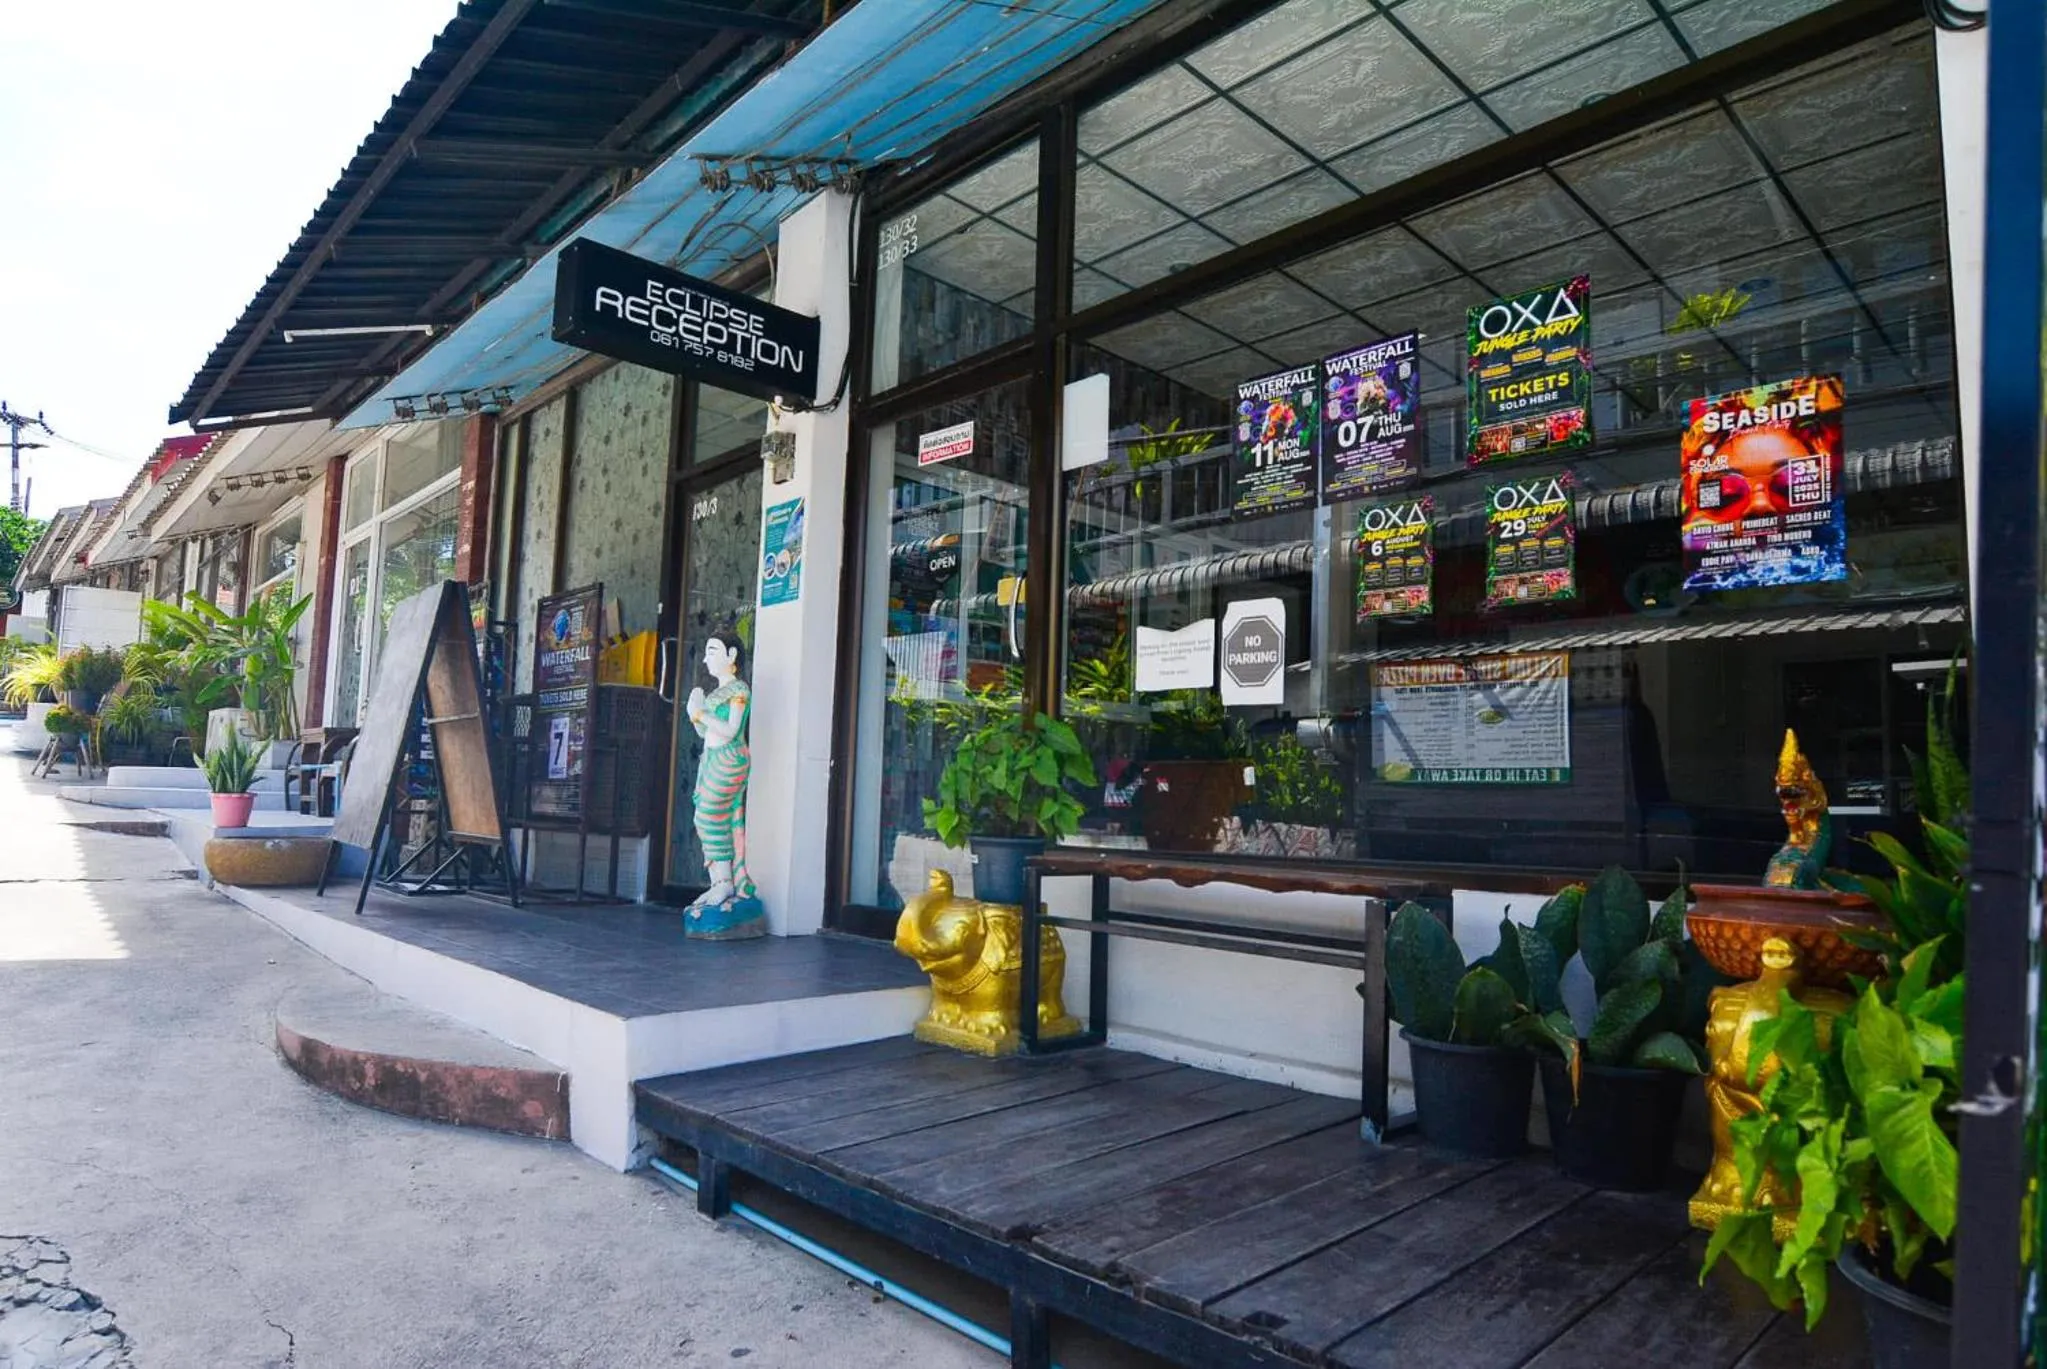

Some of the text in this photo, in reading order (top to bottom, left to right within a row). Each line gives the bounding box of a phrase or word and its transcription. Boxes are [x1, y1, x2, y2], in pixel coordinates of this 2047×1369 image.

[879, 214, 917, 248] 130/32
[878, 235, 918, 270] 130/33
[646, 279, 765, 336] ECLIPSE
[595, 286, 804, 373] RECEPTION
[1472, 330, 1532, 356] JUNGLE
[1532, 315, 1583, 342] PARTY
[650, 330, 755, 371] 061 757 8182
[1325, 339, 1414, 375] WATERFALL
[1349, 360, 1387, 376] FESTIVAL
[1238, 369, 1316, 400] WATERFALL
[1488, 372, 1570, 402] TICKETS
[1499, 391, 1558, 412] SOLD HERE
[1702, 394, 1816, 433] SEASIDE
[1337, 411, 1401, 448] 07 THU
[1377, 423, 1402, 439] AUG
[921, 441, 971, 462] INFORMATION
[1250, 438, 1300, 468] 11 MON
[1277, 449, 1300, 462] AUG
[1689, 456, 1728, 468] SOLAR
[1793, 459, 1819, 475] 31
[1793, 475, 1819, 484] JULY
[1794, 491, 1820, 501] THU
[1813, 510, 1832, 520] BEAT
[1500, 519, 1526, 539] 29
[1527, 514, 1547, 524] JULY
[1371, 539, 1383, 556] 6
[929, 555, 956, 572] OPEN
[1244, 635, 1262, 648] NO
[541, 645, 591, 667] WATERFALL
[1229, 651, 1278, 665] PARKING
[554, 731, 563, 765] 7
